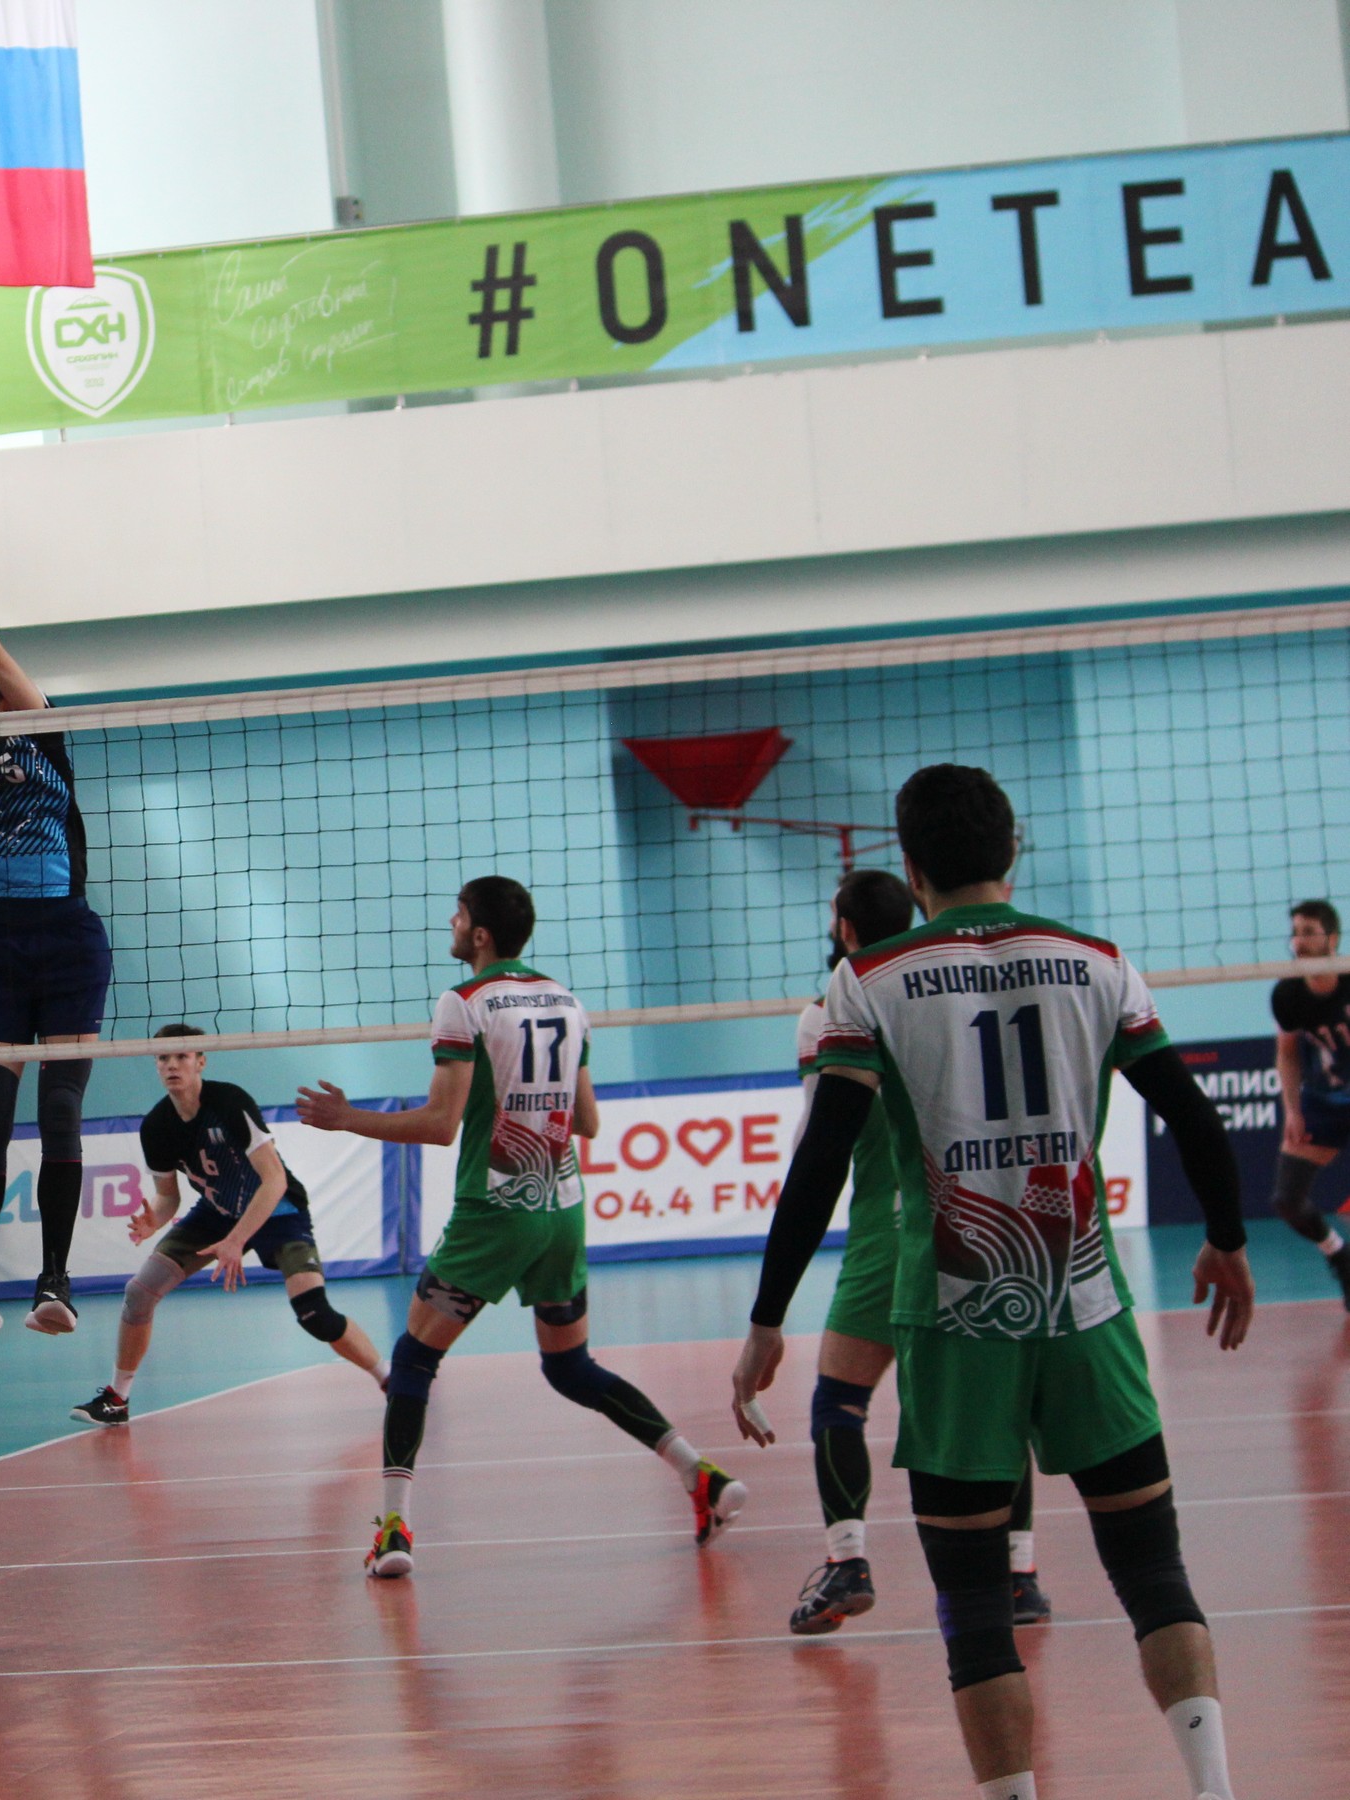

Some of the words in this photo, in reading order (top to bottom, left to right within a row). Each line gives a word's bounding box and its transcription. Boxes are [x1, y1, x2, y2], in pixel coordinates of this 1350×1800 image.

[902, 957, 1091, 1000] НУЦАЛХАНОВ
[519, 1017, 567, 1083] 17
[969, 1004, 1051, 1121] 11
[593, 1186, 694, 1221] 04.4
[713, 1180, 782, 1213] FM
